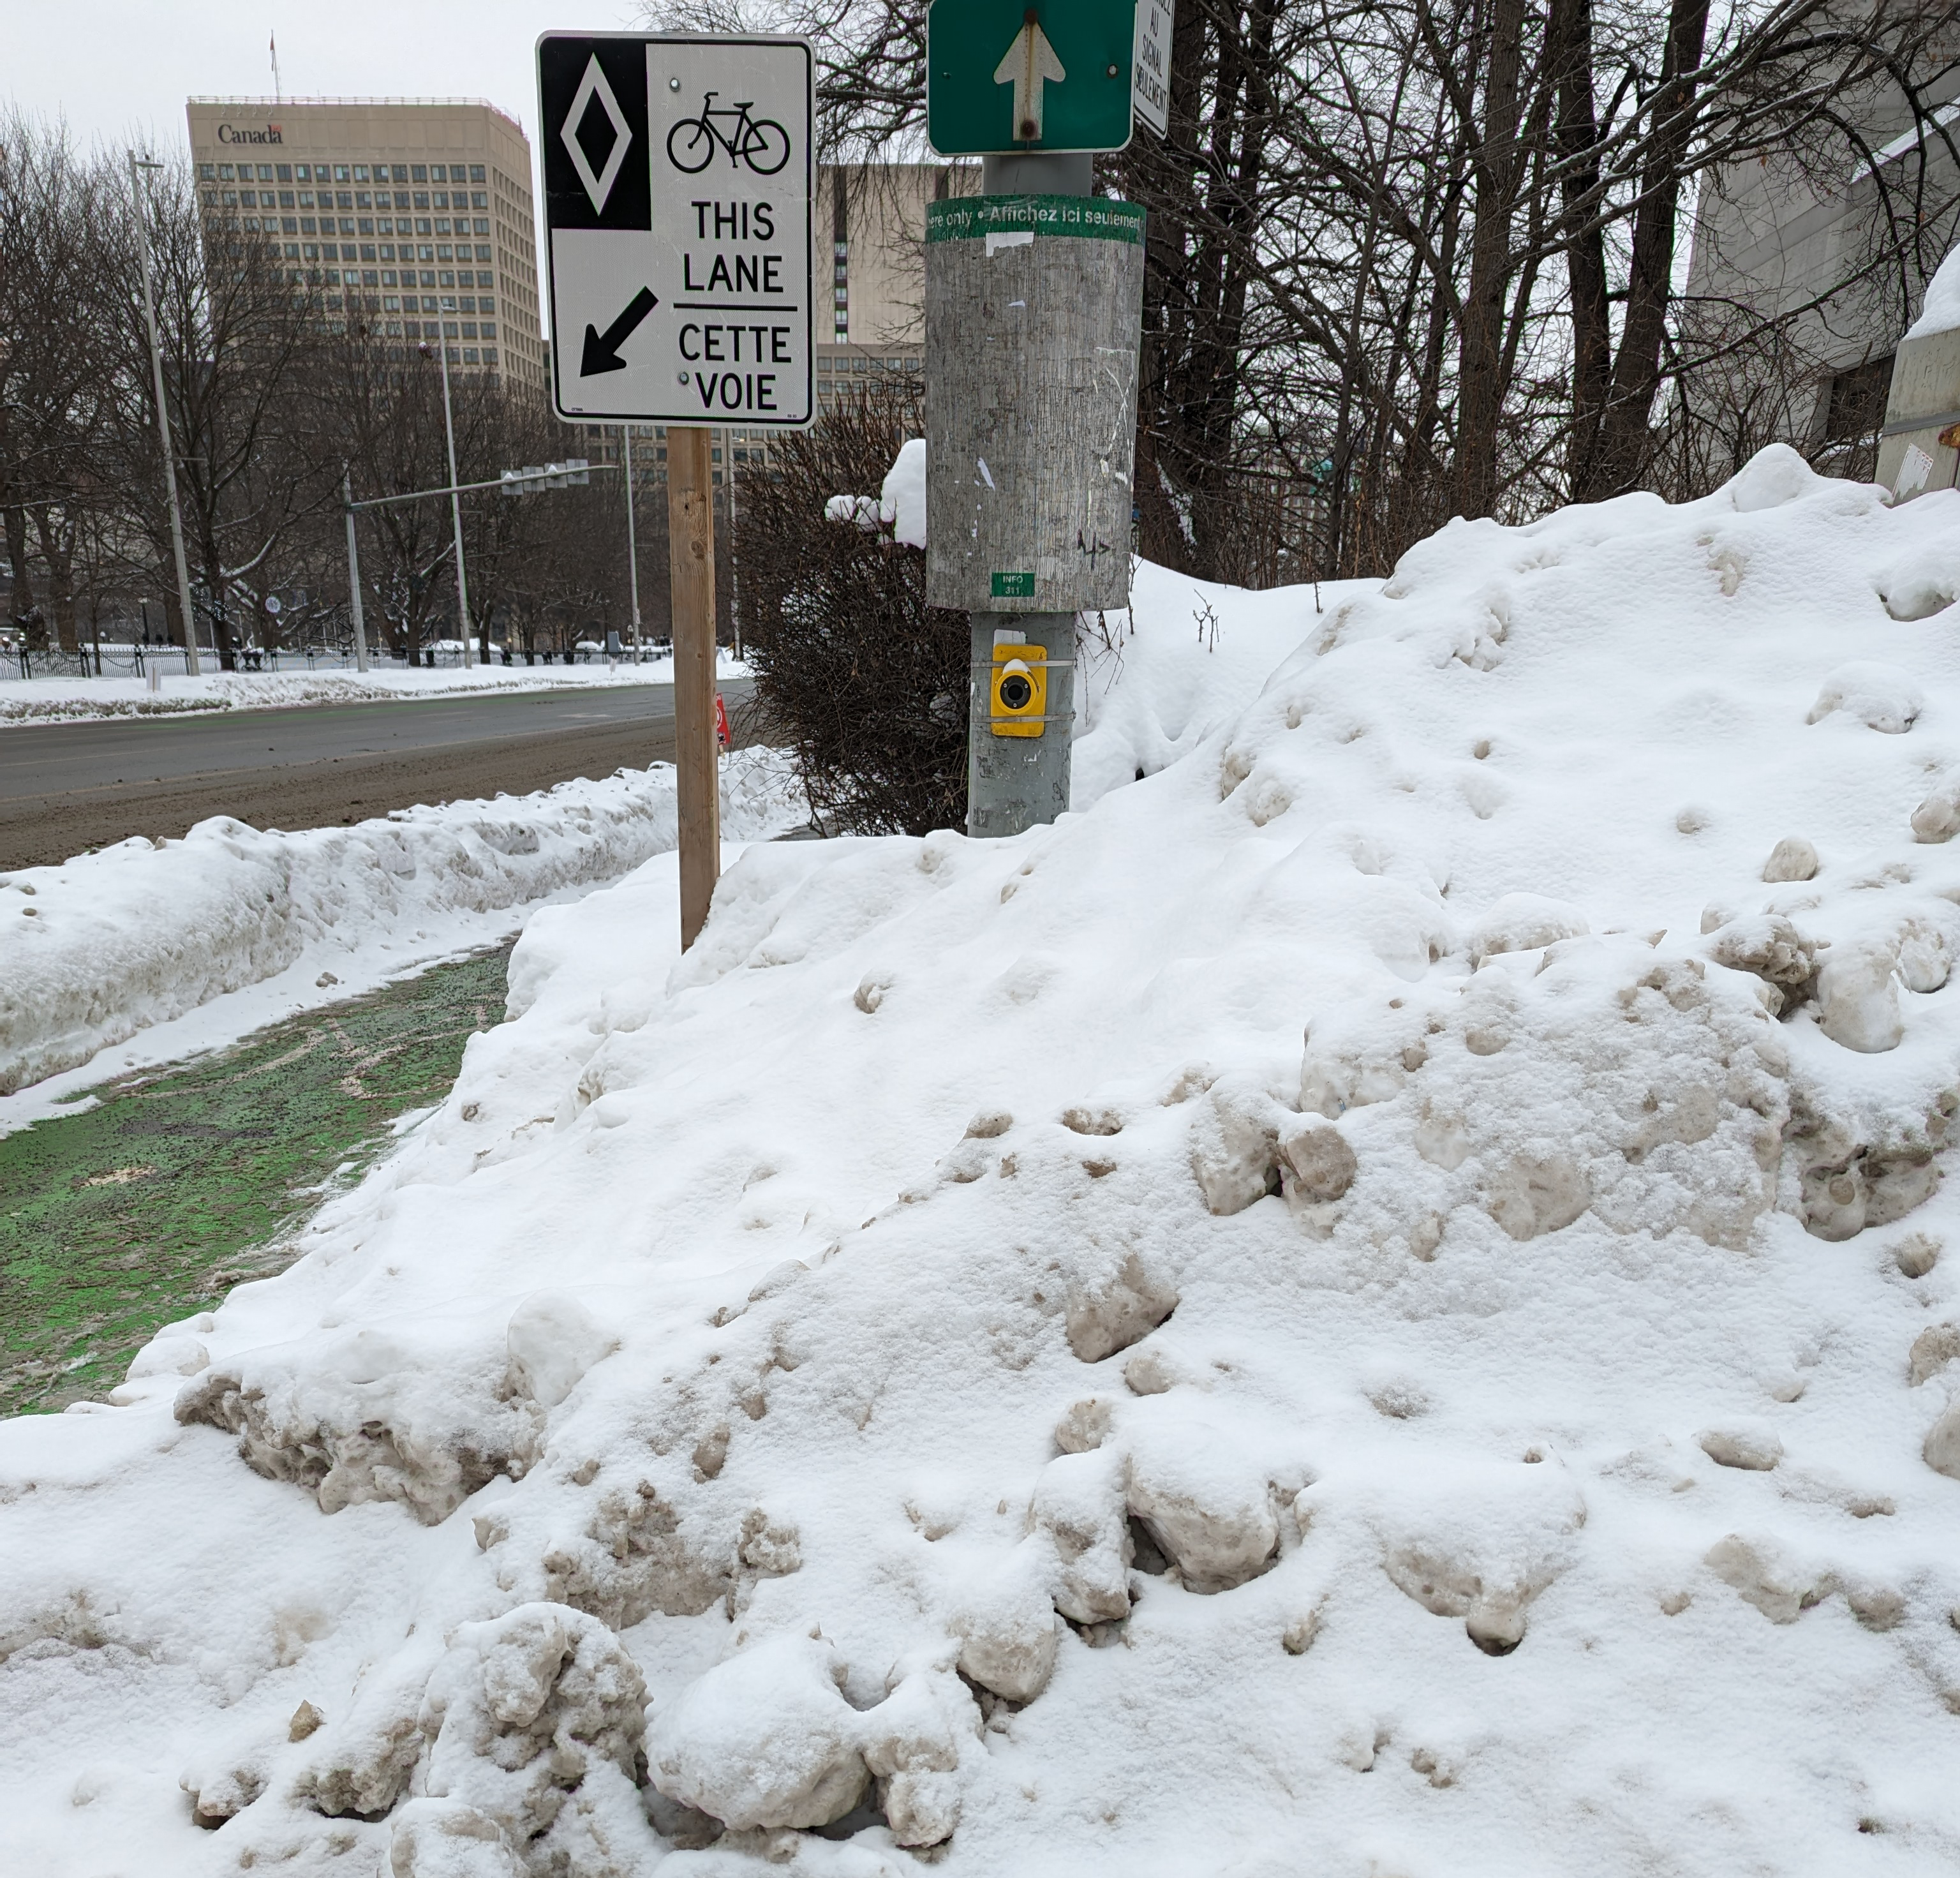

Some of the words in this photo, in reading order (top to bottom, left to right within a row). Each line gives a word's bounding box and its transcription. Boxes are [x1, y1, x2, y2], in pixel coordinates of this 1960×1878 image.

[1150, 6, 1159, 37] AU
[1141, 33, 1162, 78] SIGNAL
[1135, 62, 1167, 115] SEULEMENT
[218, 124, 283, 144] Canada
[691, 201, 775, 241] THIS
[946, 208, 973, 232] only
[989, 205, 1057, 222] Affichez
[1062, 205, 1080, 223] ici
[684, 253, 784, 292] LANE
[679, 324, 792, 363] CETTE
[695, 372, 778, 410] VOIE
[1003, 576, 1023, 584] INFO
